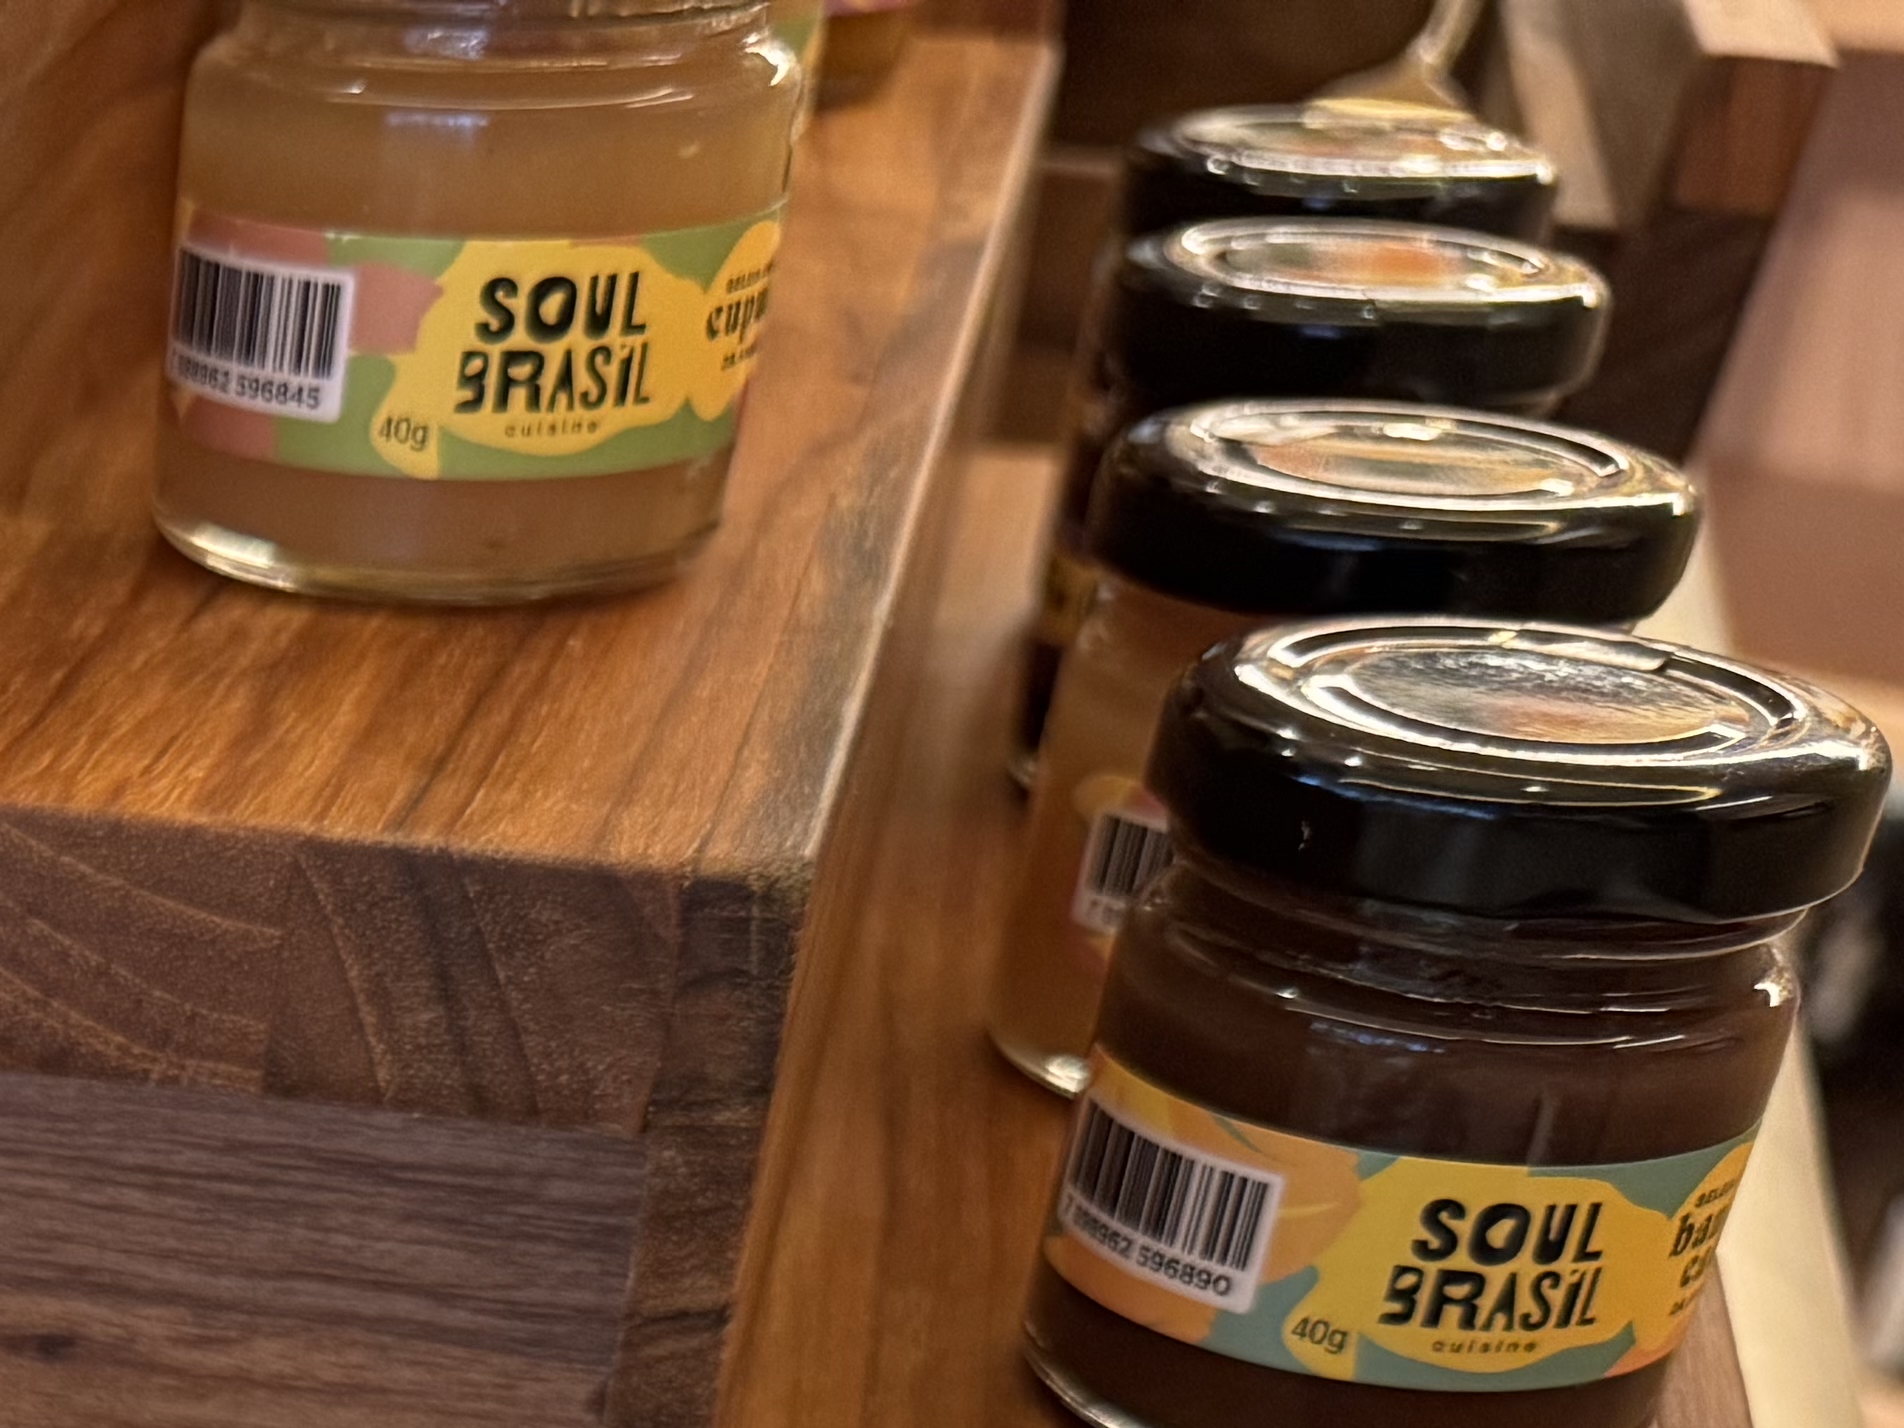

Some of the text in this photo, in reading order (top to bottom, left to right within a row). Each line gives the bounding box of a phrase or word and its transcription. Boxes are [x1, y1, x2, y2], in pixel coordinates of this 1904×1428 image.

[473, 271, 647, 344] SOUL
[235, 373, 322, 410] 596845
[377, 415, 429, 453] 40g
[504, 418, 598, 438] cuisine
[1410, 1198, 1604, 1267] SOUL
[1135, 1244, 1231, 1297] 596890
[1290, 1315, 1349, 1355] 40g
[1431, 1338, 1539, 1354] cuisine
